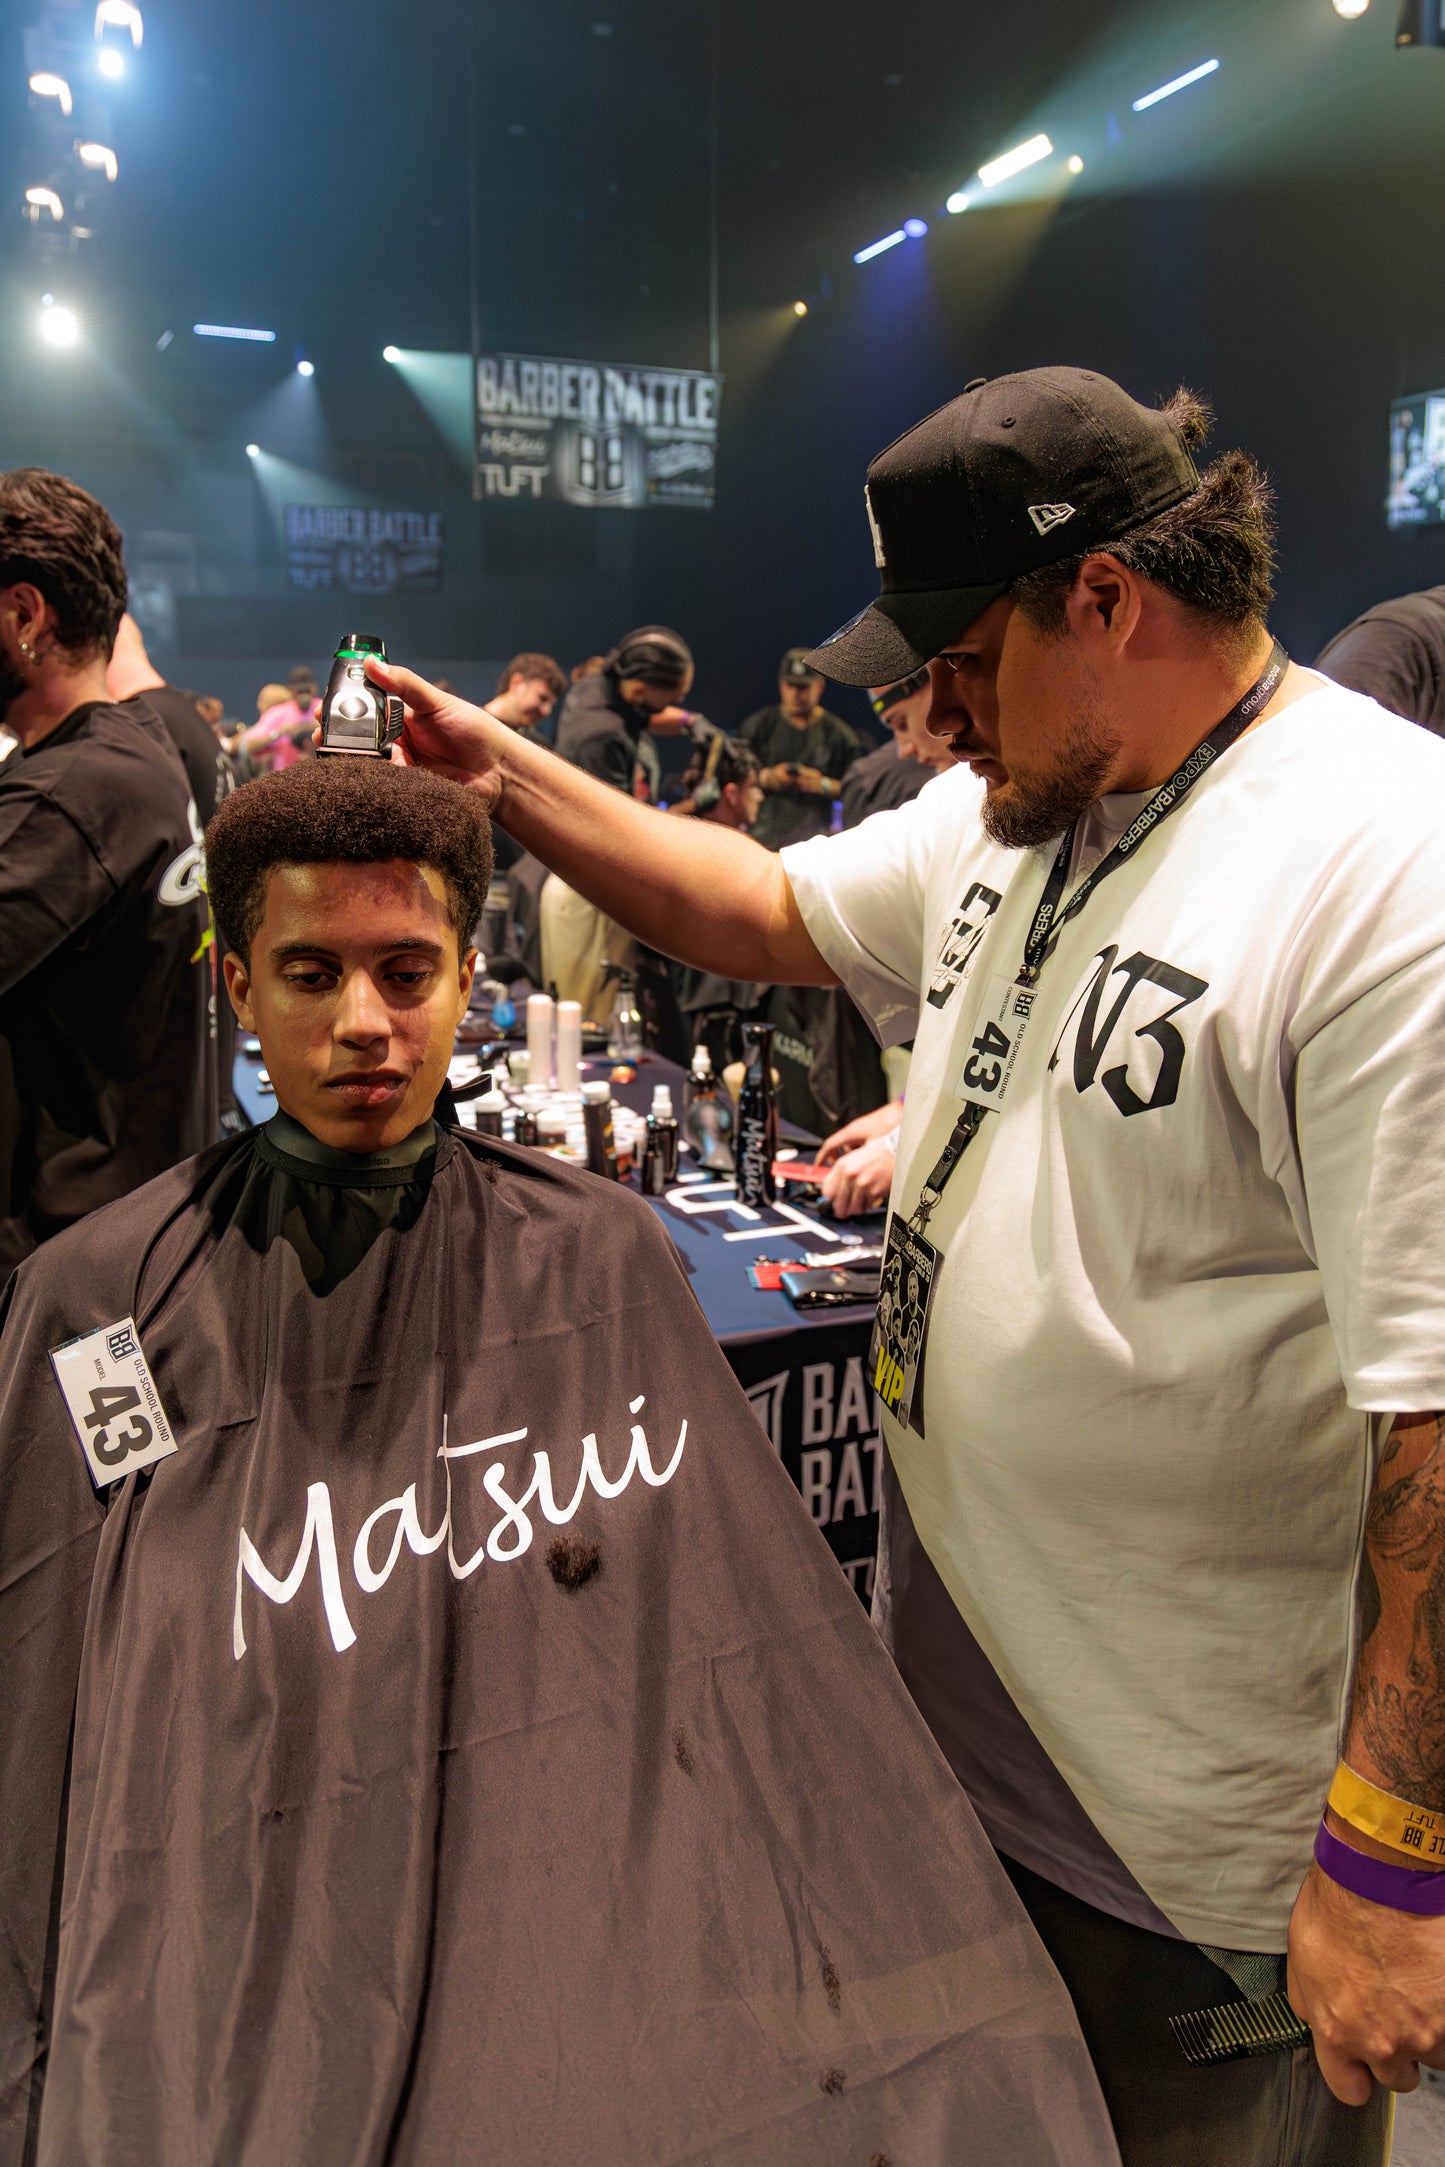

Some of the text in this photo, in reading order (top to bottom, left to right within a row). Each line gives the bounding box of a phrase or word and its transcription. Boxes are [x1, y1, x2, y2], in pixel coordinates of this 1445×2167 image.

[477, 358, 599, 420] BARBER
[480, 464, 550, 498] TUFT
[1241, 664, 1281, 715] mochagroup
[998, 986, 1013, 1021] CONTESTANT
[963, 1021, 1011, 1092] 43
[998, 1023, 1028, 1099] OLD SCHOOL ROUND
[94, 1358, 106, 1381] MODEL
[134, 1358, 170, 1442] OLD SCHOOL ROUND
[873, 1345, 905, 1407] VIP
[83, 1386, 153, 1466] 43
[233, 1394, 688, 1661] Matsui
[1403, 1811, 1436, 1830] TUFT
